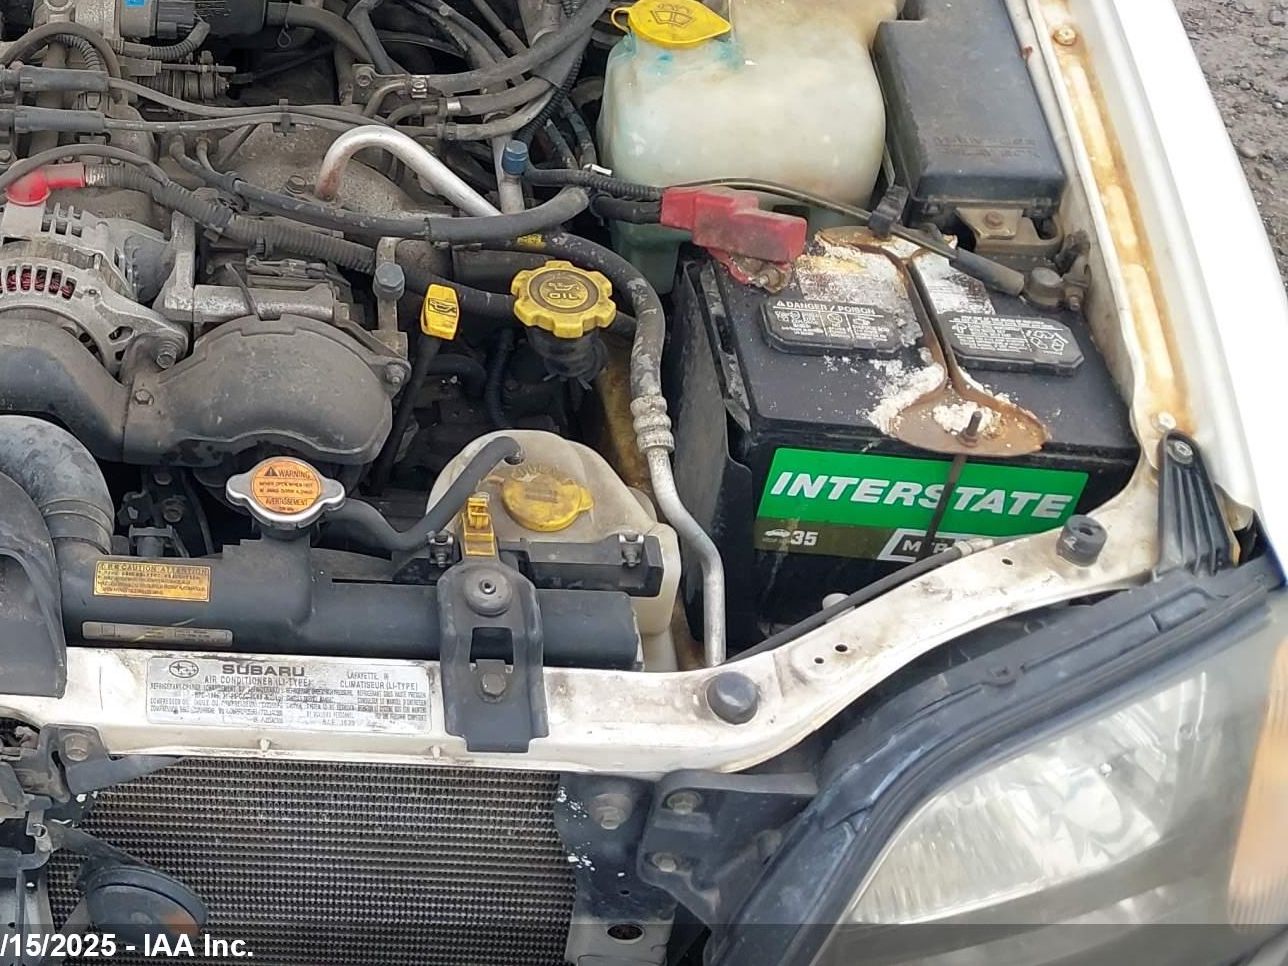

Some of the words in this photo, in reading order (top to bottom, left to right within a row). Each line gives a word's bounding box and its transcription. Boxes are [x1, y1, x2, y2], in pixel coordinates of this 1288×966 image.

[786, 301, 828, 311] DANGER
[838, 305, 876, 315] POISON
[278, 469, 310, 479] WARNING
[770, 472, 1073, 519] INTERSTATE
[791, 530, 819, 546] 35
[222, 665, 304, 676] SUBARU
[204, 675, 218, 684] AIR
[220, 676, 274, 686] CONDITIONER
[339, 680, 385, 690] CLIMATISEUR
